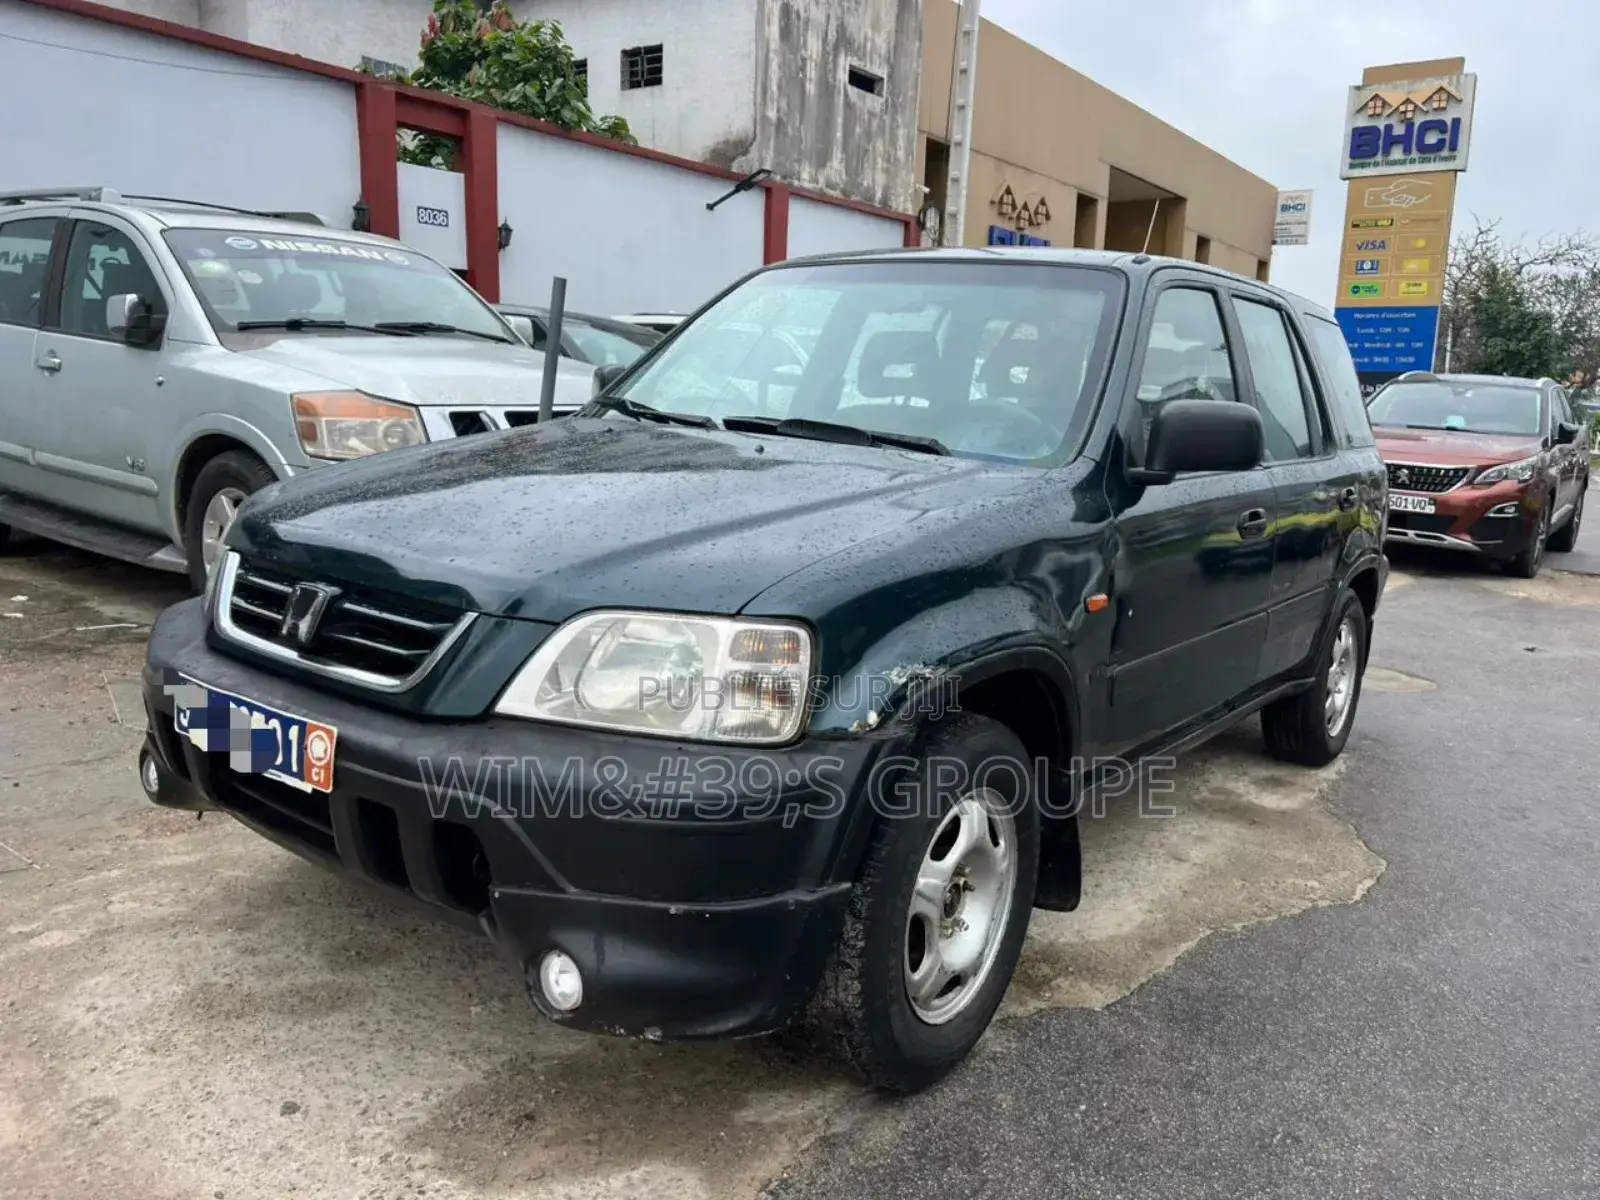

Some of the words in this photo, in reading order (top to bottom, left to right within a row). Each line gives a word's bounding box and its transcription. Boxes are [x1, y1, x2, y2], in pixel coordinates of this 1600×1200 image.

[1349, 117, 1462, 160] BHCI
[1280, 202, 1306, 213] BHCI
[418, 208, 448, 226] 8036
[259, 239, 384, 261] NISSAN
[1356, 239, 1387, 251] VISA
